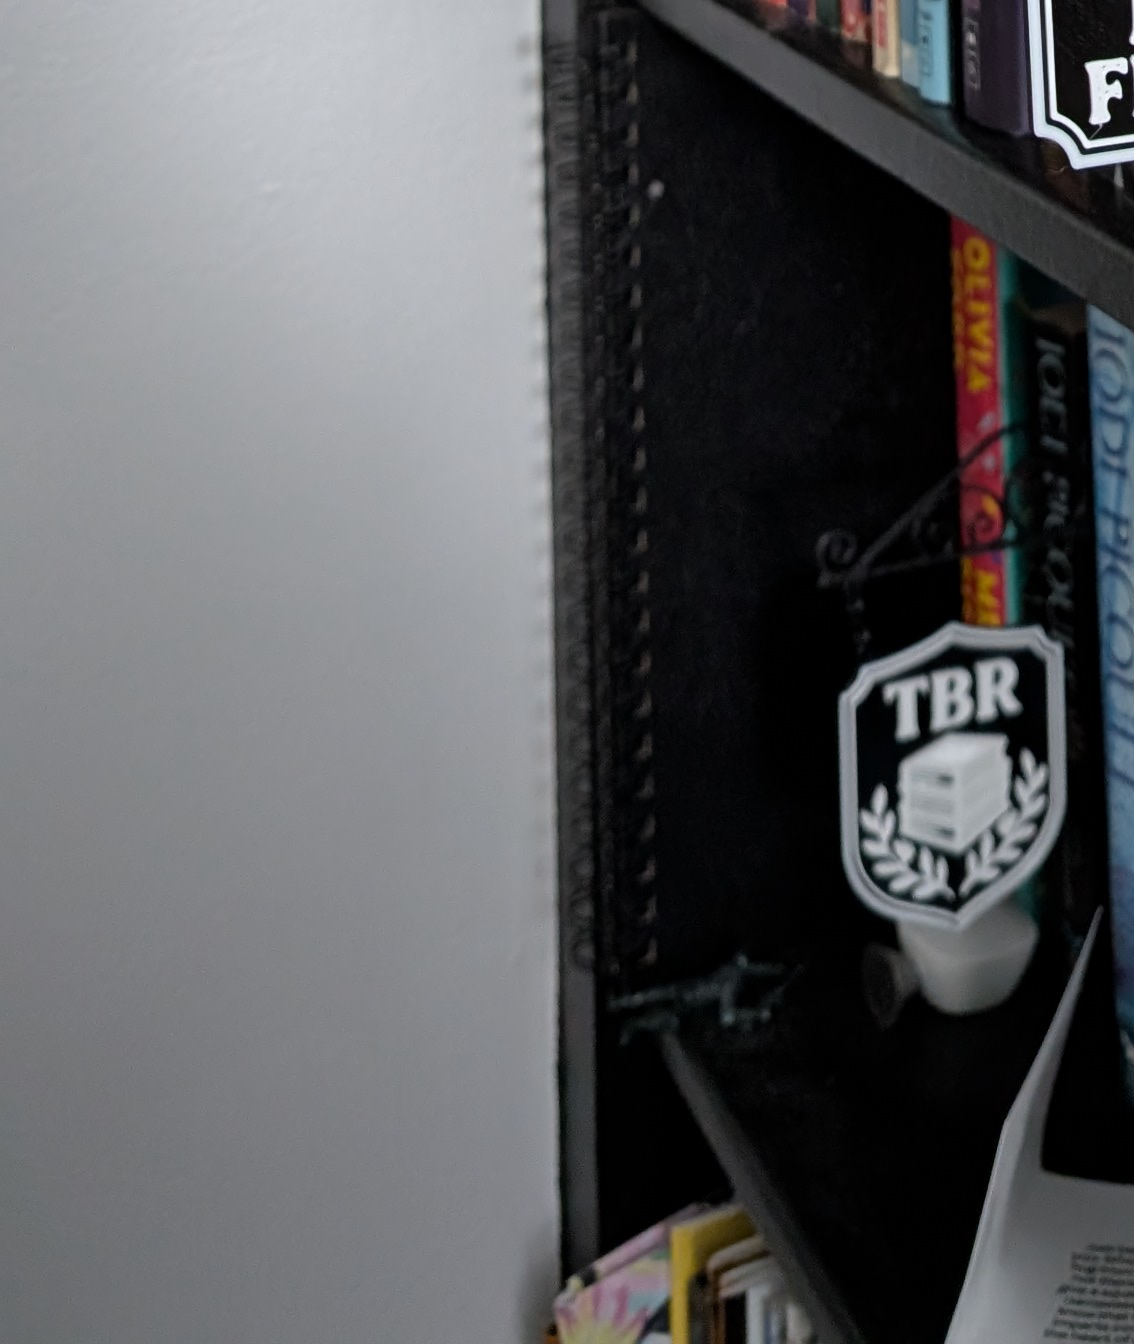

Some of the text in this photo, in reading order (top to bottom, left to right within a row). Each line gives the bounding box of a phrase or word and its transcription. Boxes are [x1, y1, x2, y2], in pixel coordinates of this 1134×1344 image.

[963, 237, 992, 393] OLIVIA
[1095, 326, 1131, 480] JODI
[882, 656, 1023, 744] TBR
